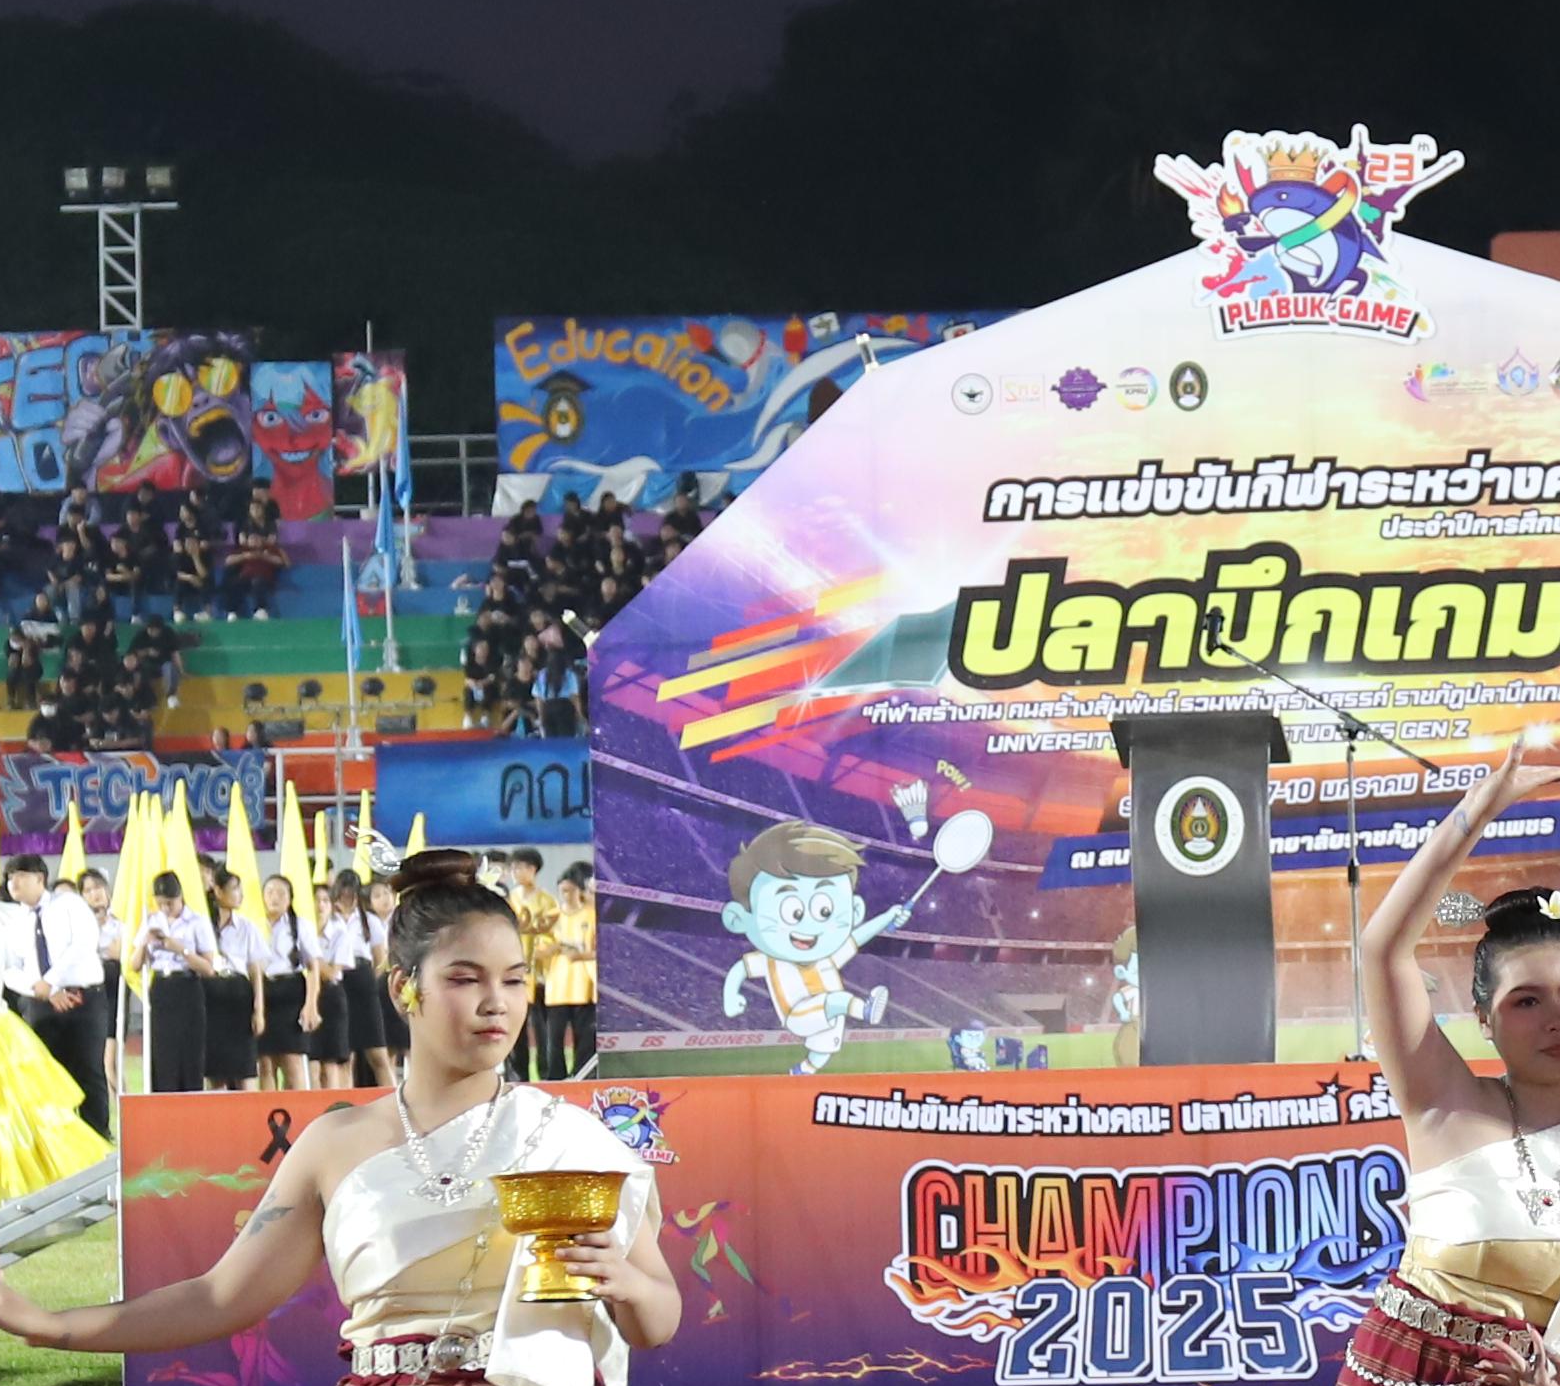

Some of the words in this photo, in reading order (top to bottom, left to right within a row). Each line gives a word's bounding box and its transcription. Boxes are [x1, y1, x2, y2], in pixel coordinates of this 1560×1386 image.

[1225, 293, 1326, 330] PLABUK
[1336, 295, 1419, 332] GAME
[1400, 719, 1449, 741] GEN
[1452, 718, 1471, 739] Z
[936, 759, 972, 792] POW!
[685, 1032, 765, 1047] BUSINESS
[815, 1089, 1173, 1137] การแข่งขันกีฬาระหว่างคณะ
[908, 1151, 1405, 1289] CHAMPIONS
[998, 1273, 1317, 1384] 2025
